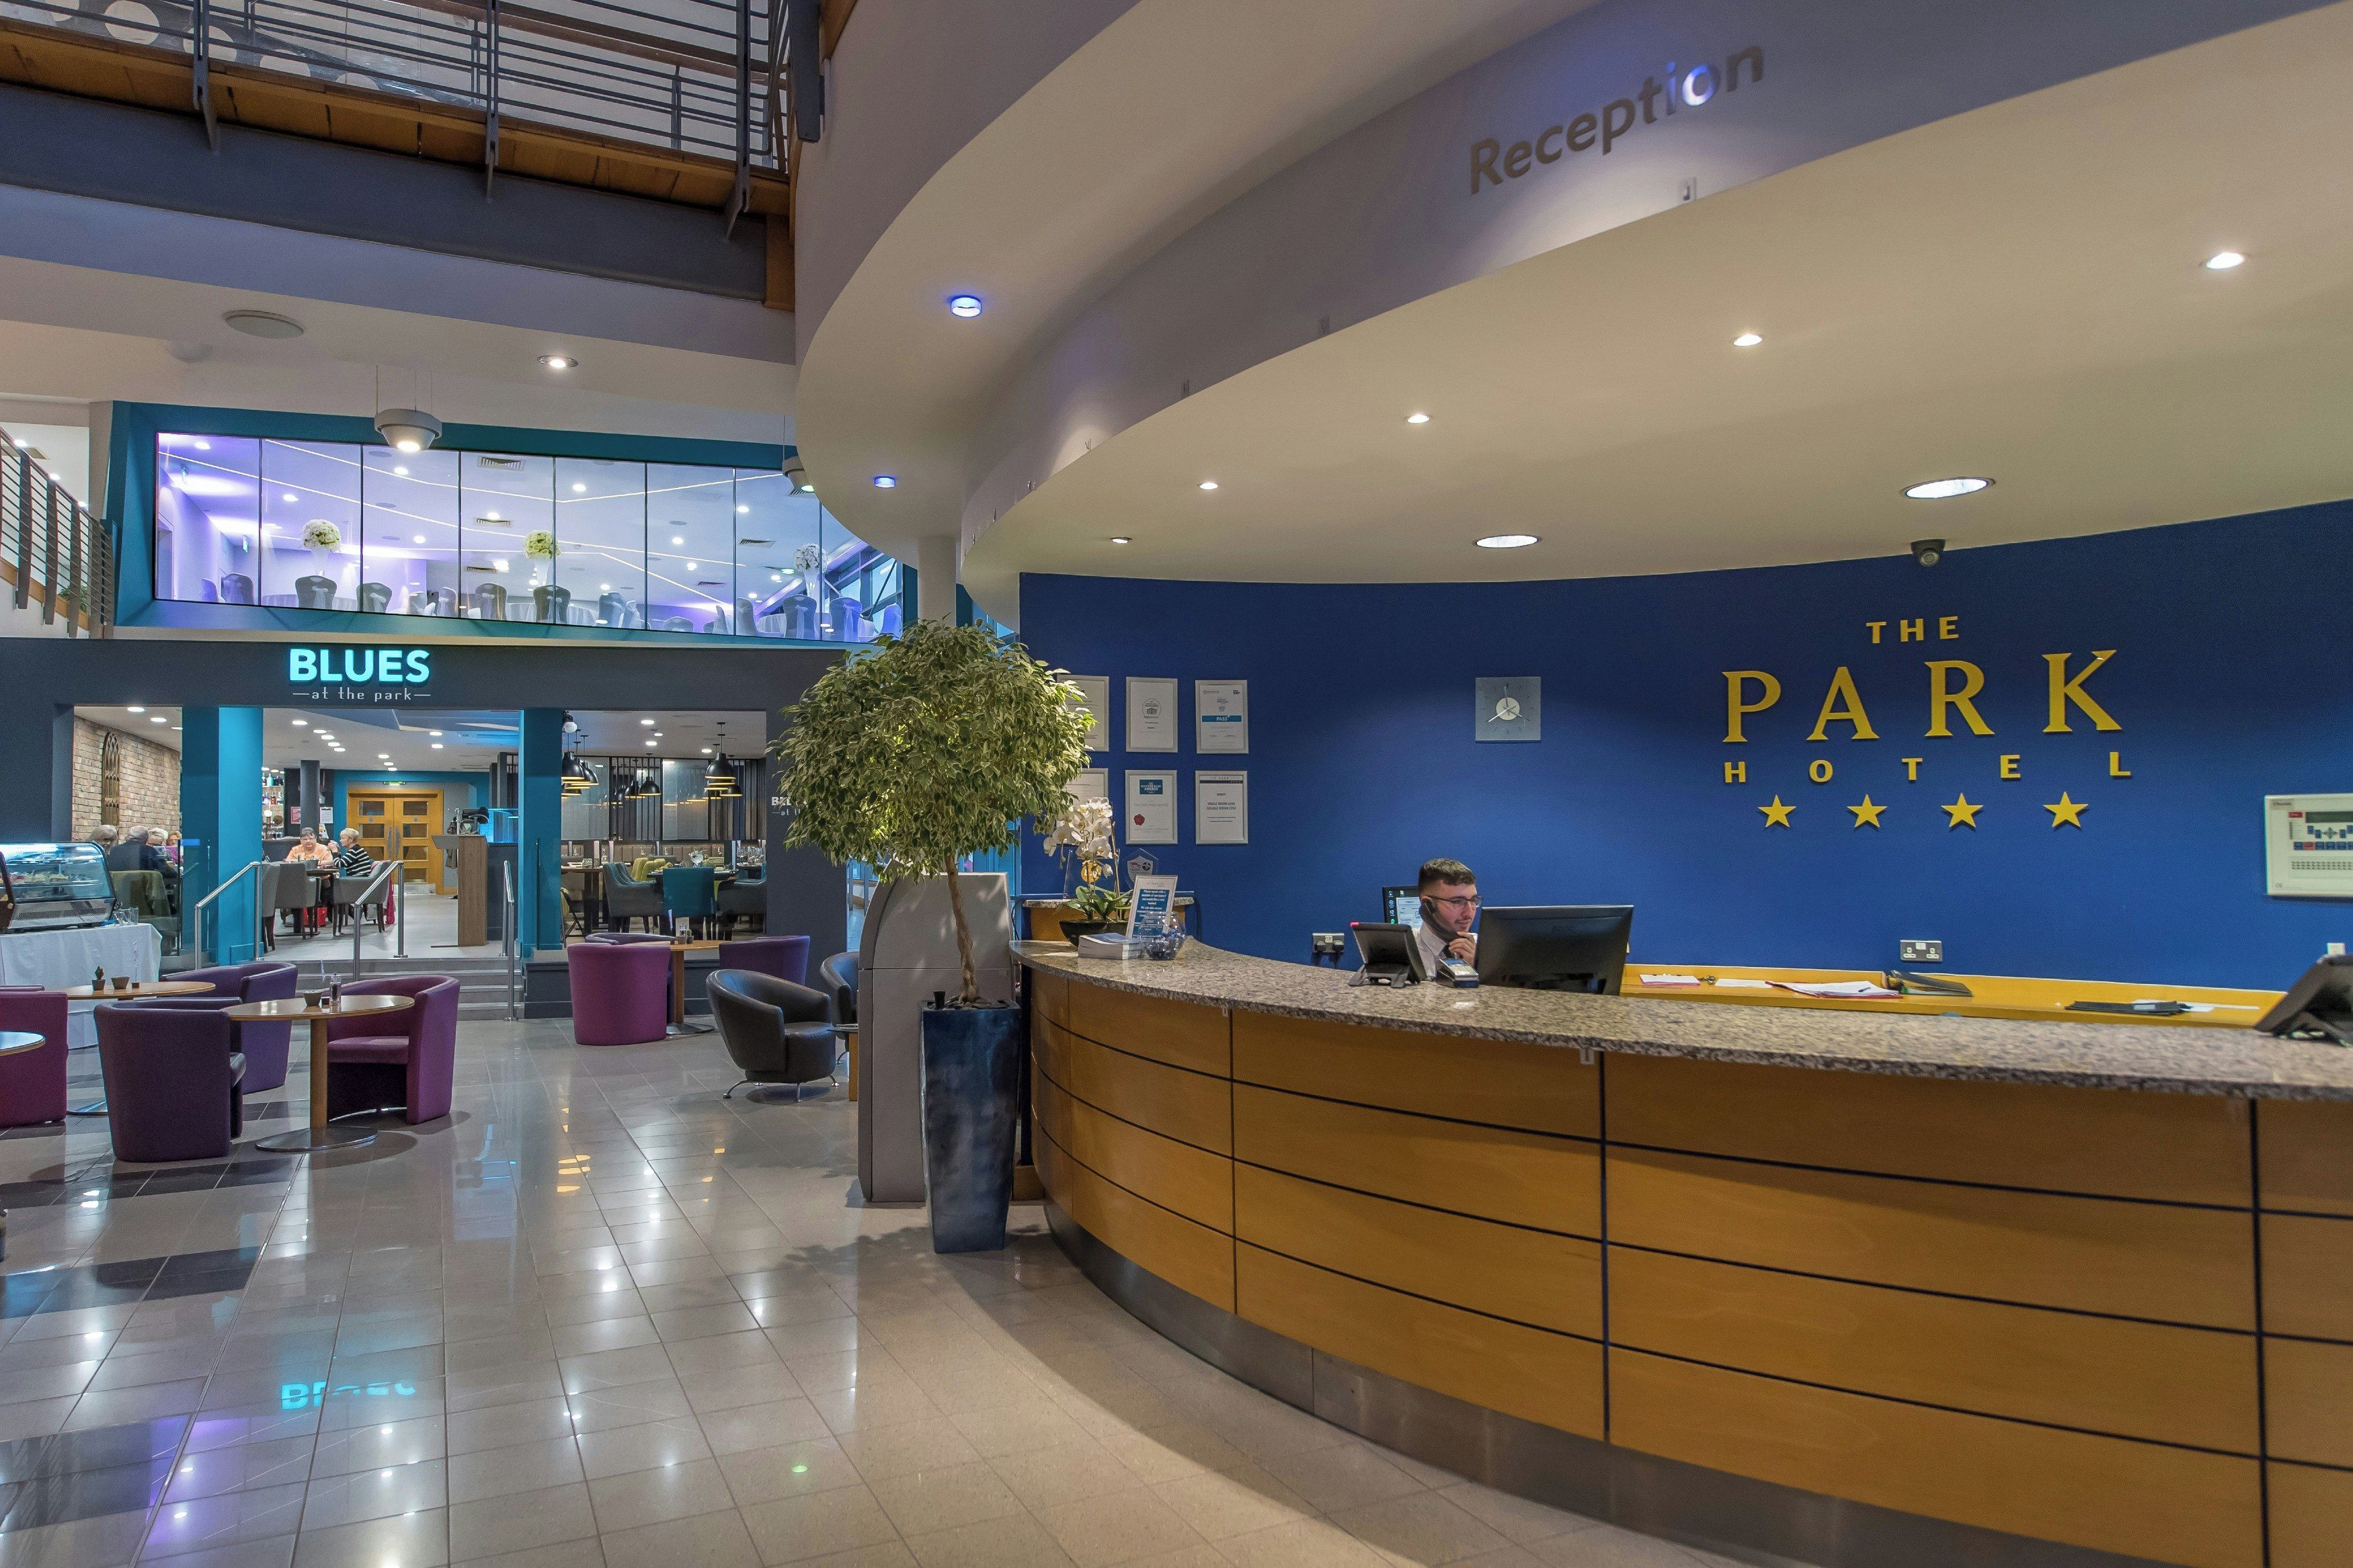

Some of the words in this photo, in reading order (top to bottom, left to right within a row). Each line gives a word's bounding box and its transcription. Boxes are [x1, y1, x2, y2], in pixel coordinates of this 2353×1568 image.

[1470, 44, 1764, 196] Reception
[1866, 616, 1959, 644] THE
[290, 649, 430, 683] BLUES
[312, 687, 328, 700] at
[338, 687, 364, 700] the
[374, 688, 411, 702] park
[1722, 650, 2123, 743] PARK
[1724, 751, 2132, 783] HOTEL
